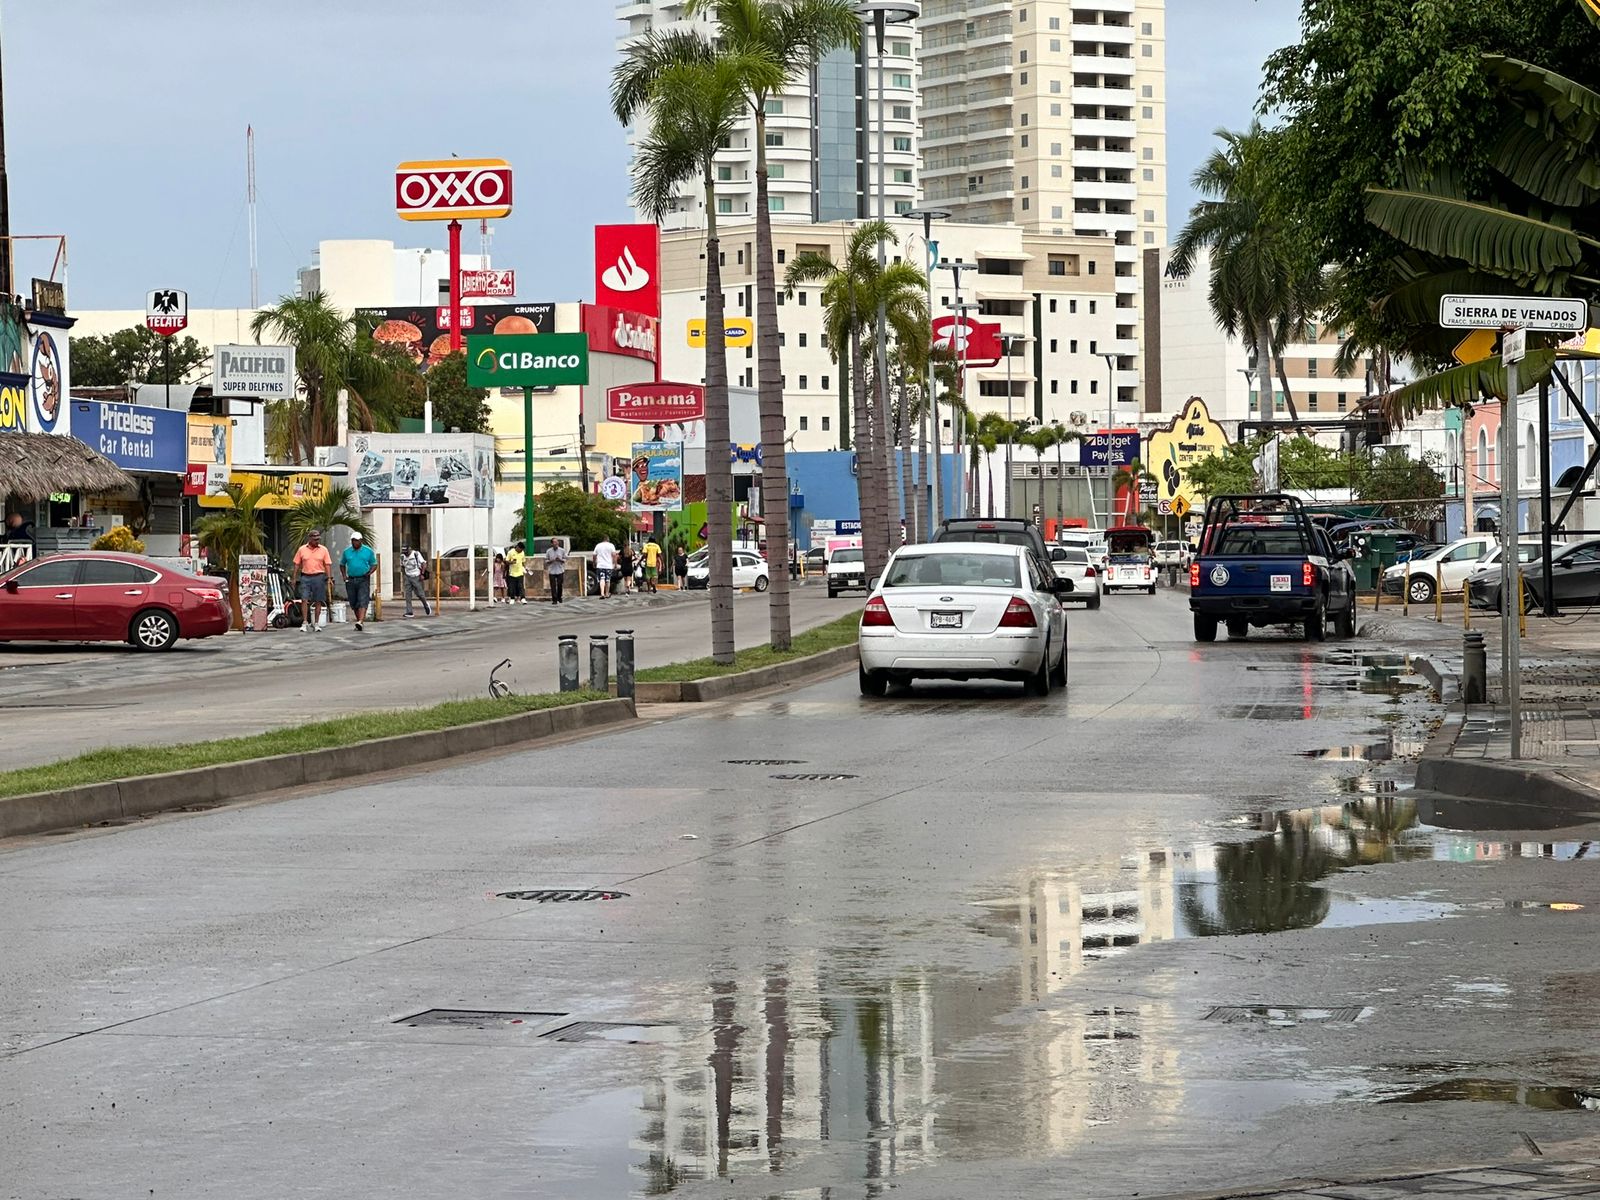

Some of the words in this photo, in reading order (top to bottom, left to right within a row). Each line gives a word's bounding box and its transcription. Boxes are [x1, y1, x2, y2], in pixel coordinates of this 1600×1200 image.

[401, 169, 504, 208] OXXO
[488, 272, 512, 289] 24
[515, 306, 551, 314] CRUNCHY
[1454, 307, 1498, 318] SIERRA
[1502, 308, 1518, 319] DE
[1521, 309, 1578, 322] VENADOS
[148, 316, 184, 328] TECATE
[221, 351, 286, 378] PACIFICO
[223, 382, 246, 391] SUPER
[248, 383, 284, 392] DELFYNES
[618, 391, 697, 407] Panamá
[100, 403, 154, 435] Priceless
[100, 434, 118, 454] Car
[121, 436, 154, 459] Rental
[1097, 436, 1131, 448] Budget
